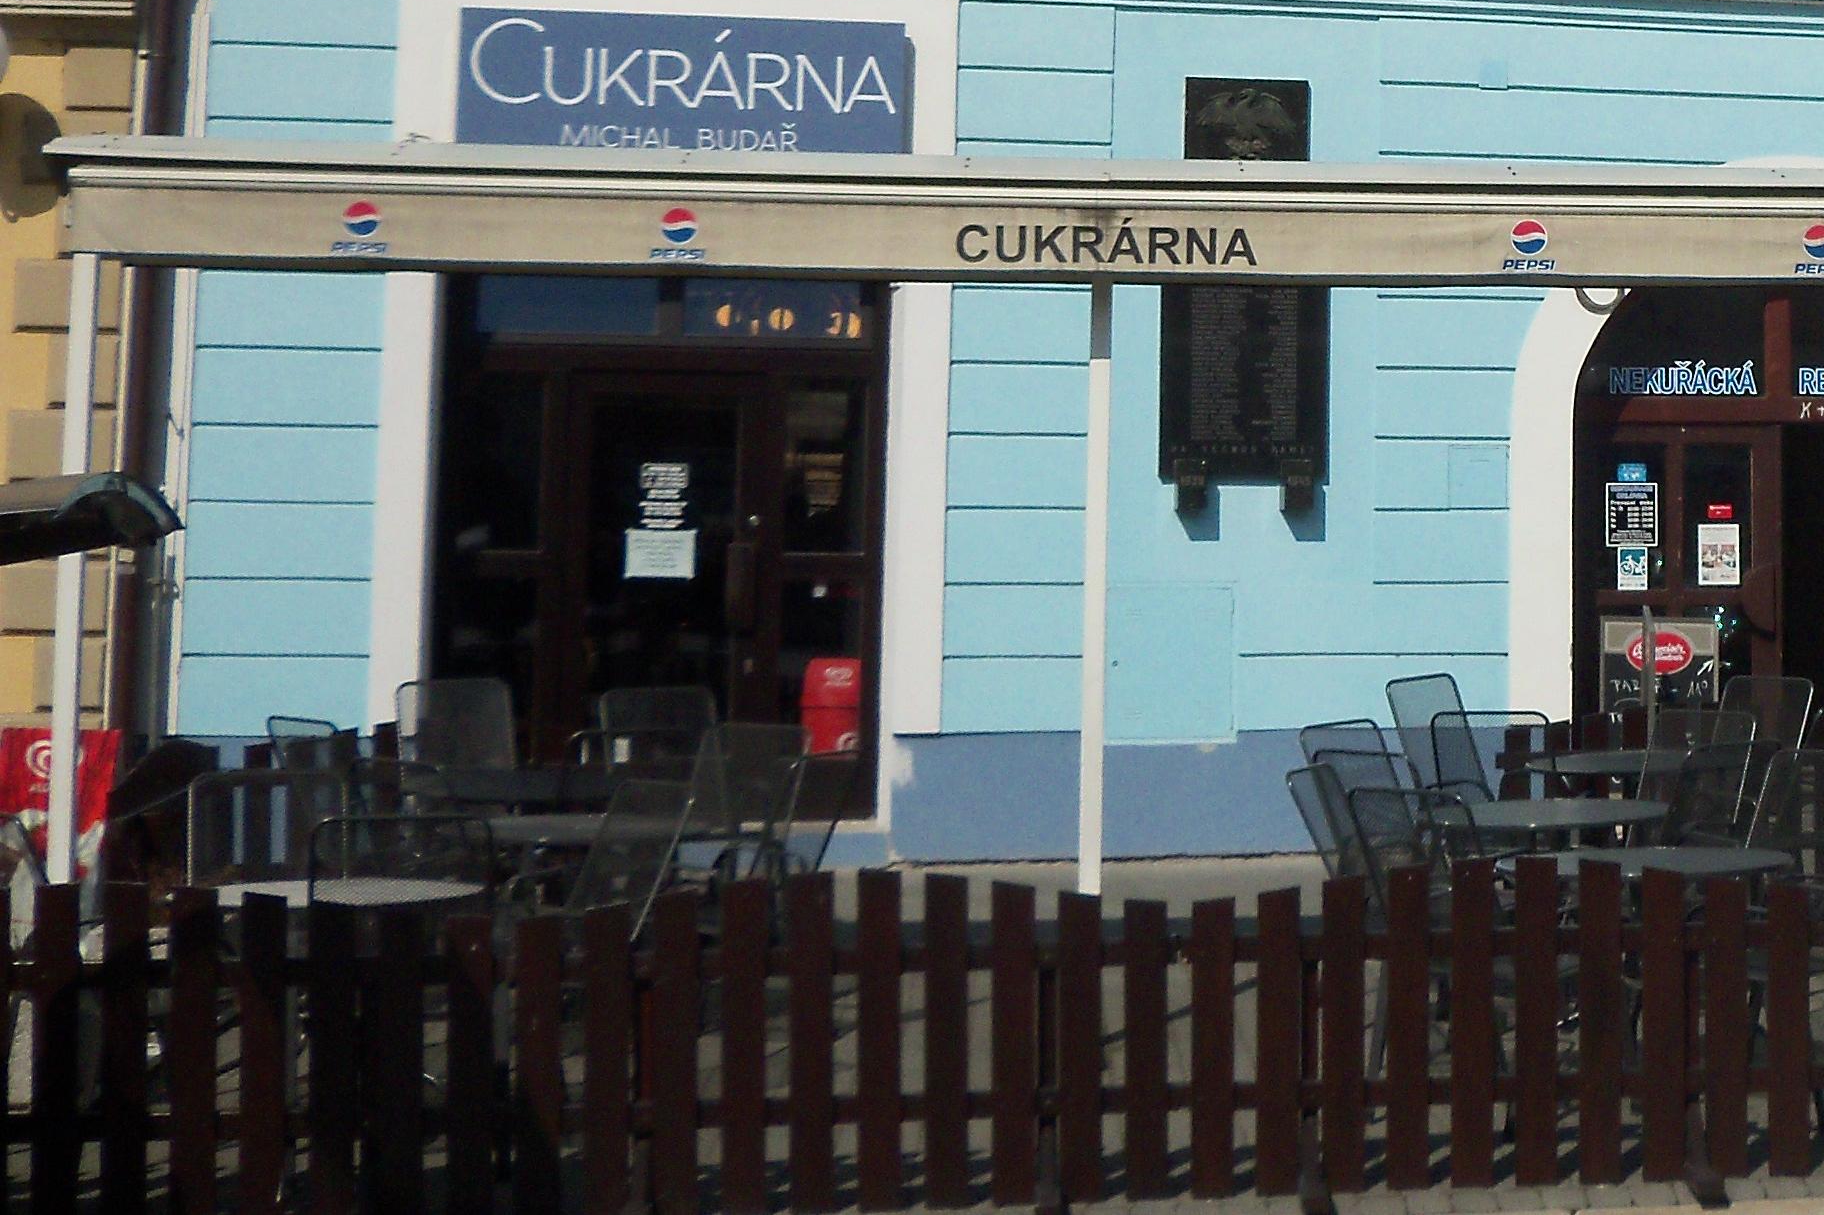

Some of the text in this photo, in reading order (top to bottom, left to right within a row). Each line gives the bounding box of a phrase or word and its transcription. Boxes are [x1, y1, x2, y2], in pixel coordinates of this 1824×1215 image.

[470, 17, 896, 115] CUKRÁRNA
[560, 123, 680, 150] MICHAL
[697, 122, 799, 152] BUDAŘ
[650, 248, 705, 260] PEPSI
[956, 217, 1258, 266] CUKRÁRNA
[1503, 259, 1555, 271] PEPSI
[1609, 360, 1757, 396] NEKUŘÁCKÁ
